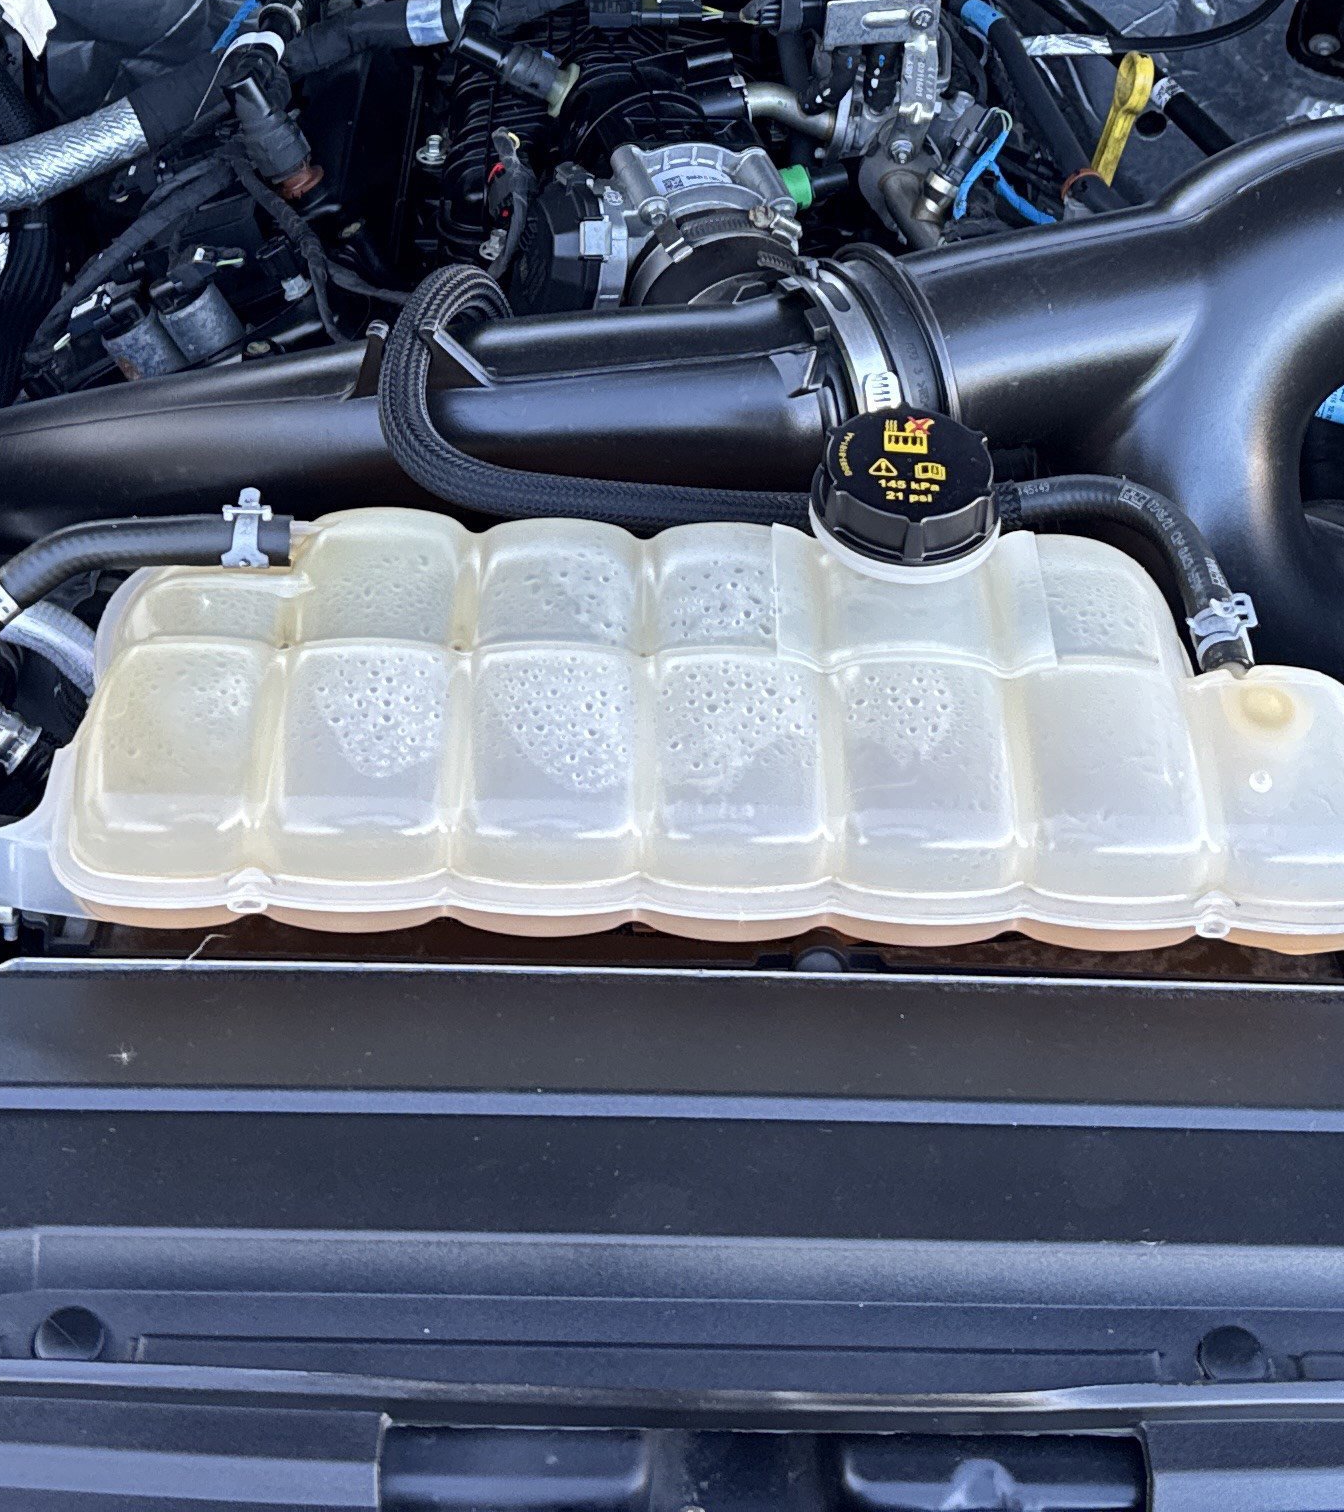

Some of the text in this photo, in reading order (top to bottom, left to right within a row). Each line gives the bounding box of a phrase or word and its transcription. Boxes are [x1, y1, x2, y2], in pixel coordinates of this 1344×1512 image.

[878, 478, 940, 492] 145 kPa
[885, 491, 933, 504] 21 psi
